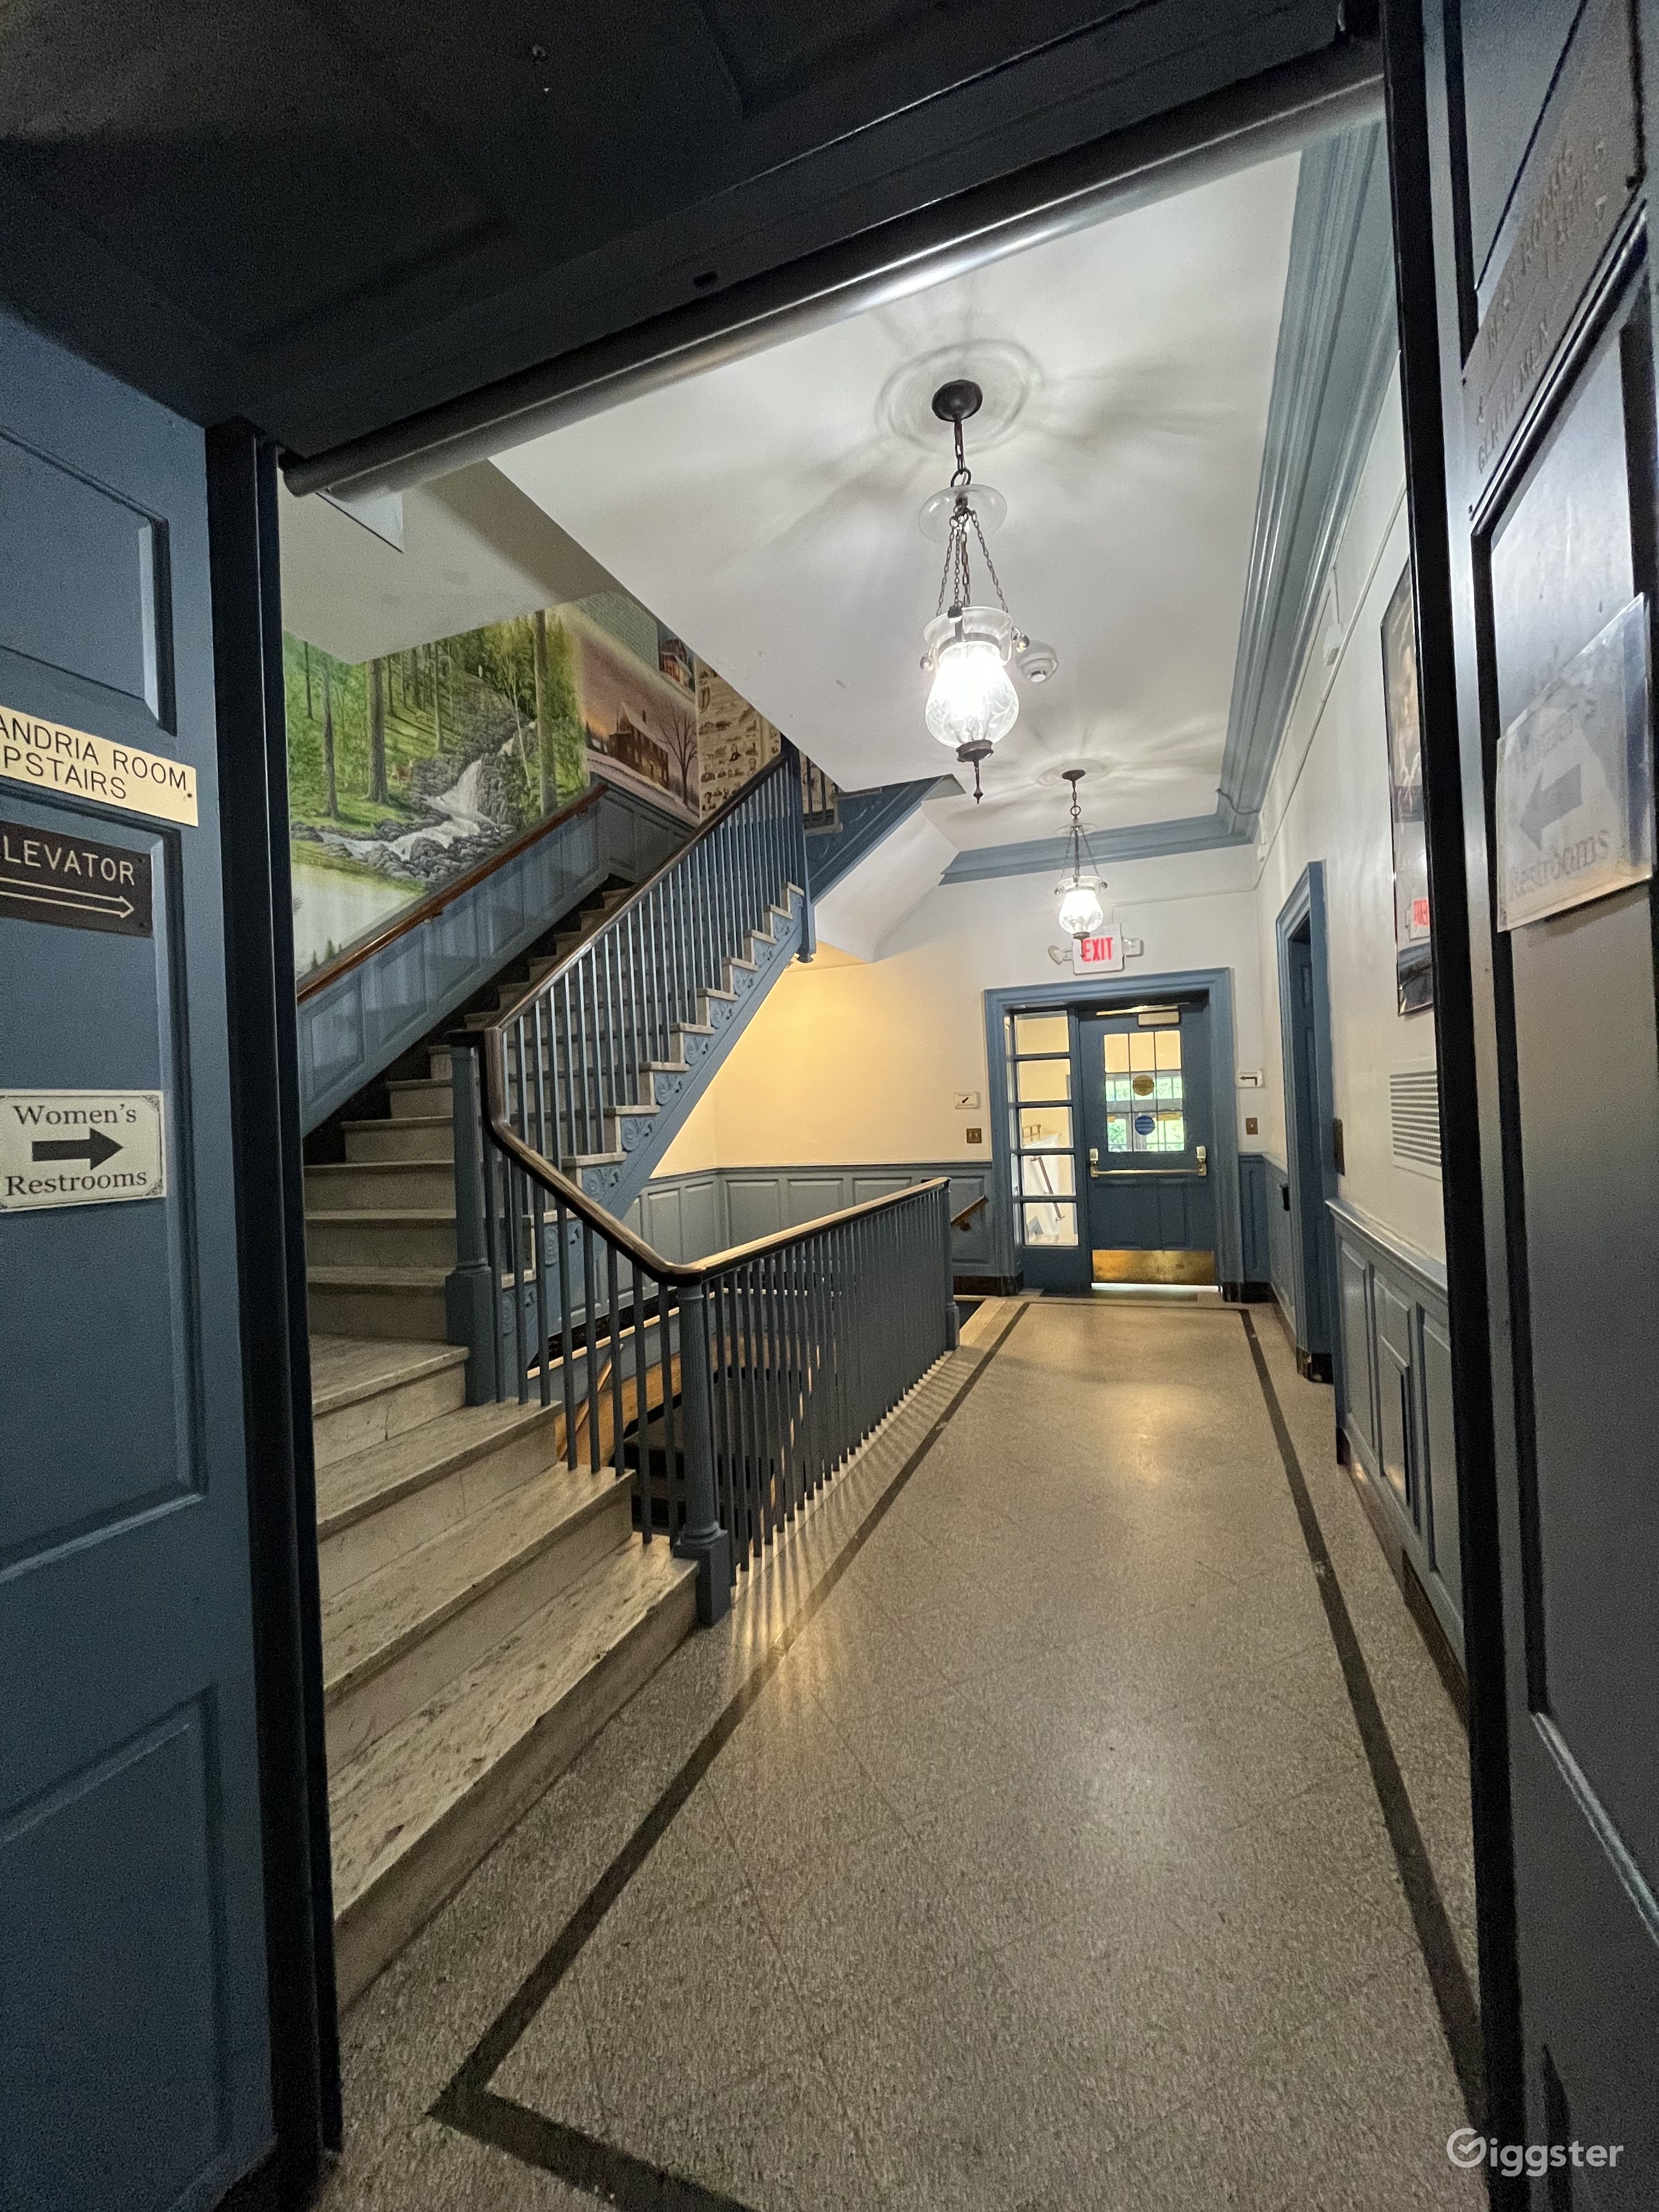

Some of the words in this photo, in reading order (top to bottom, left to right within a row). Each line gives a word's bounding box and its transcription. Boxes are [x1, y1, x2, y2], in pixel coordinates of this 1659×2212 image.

[112, 749, 187, 791] ROOM
[1082, 937, 1113, 962] EXIT
[13, 1103, 137, 1125] Women's
[5, 1171, 148, 1197] Restrooms
